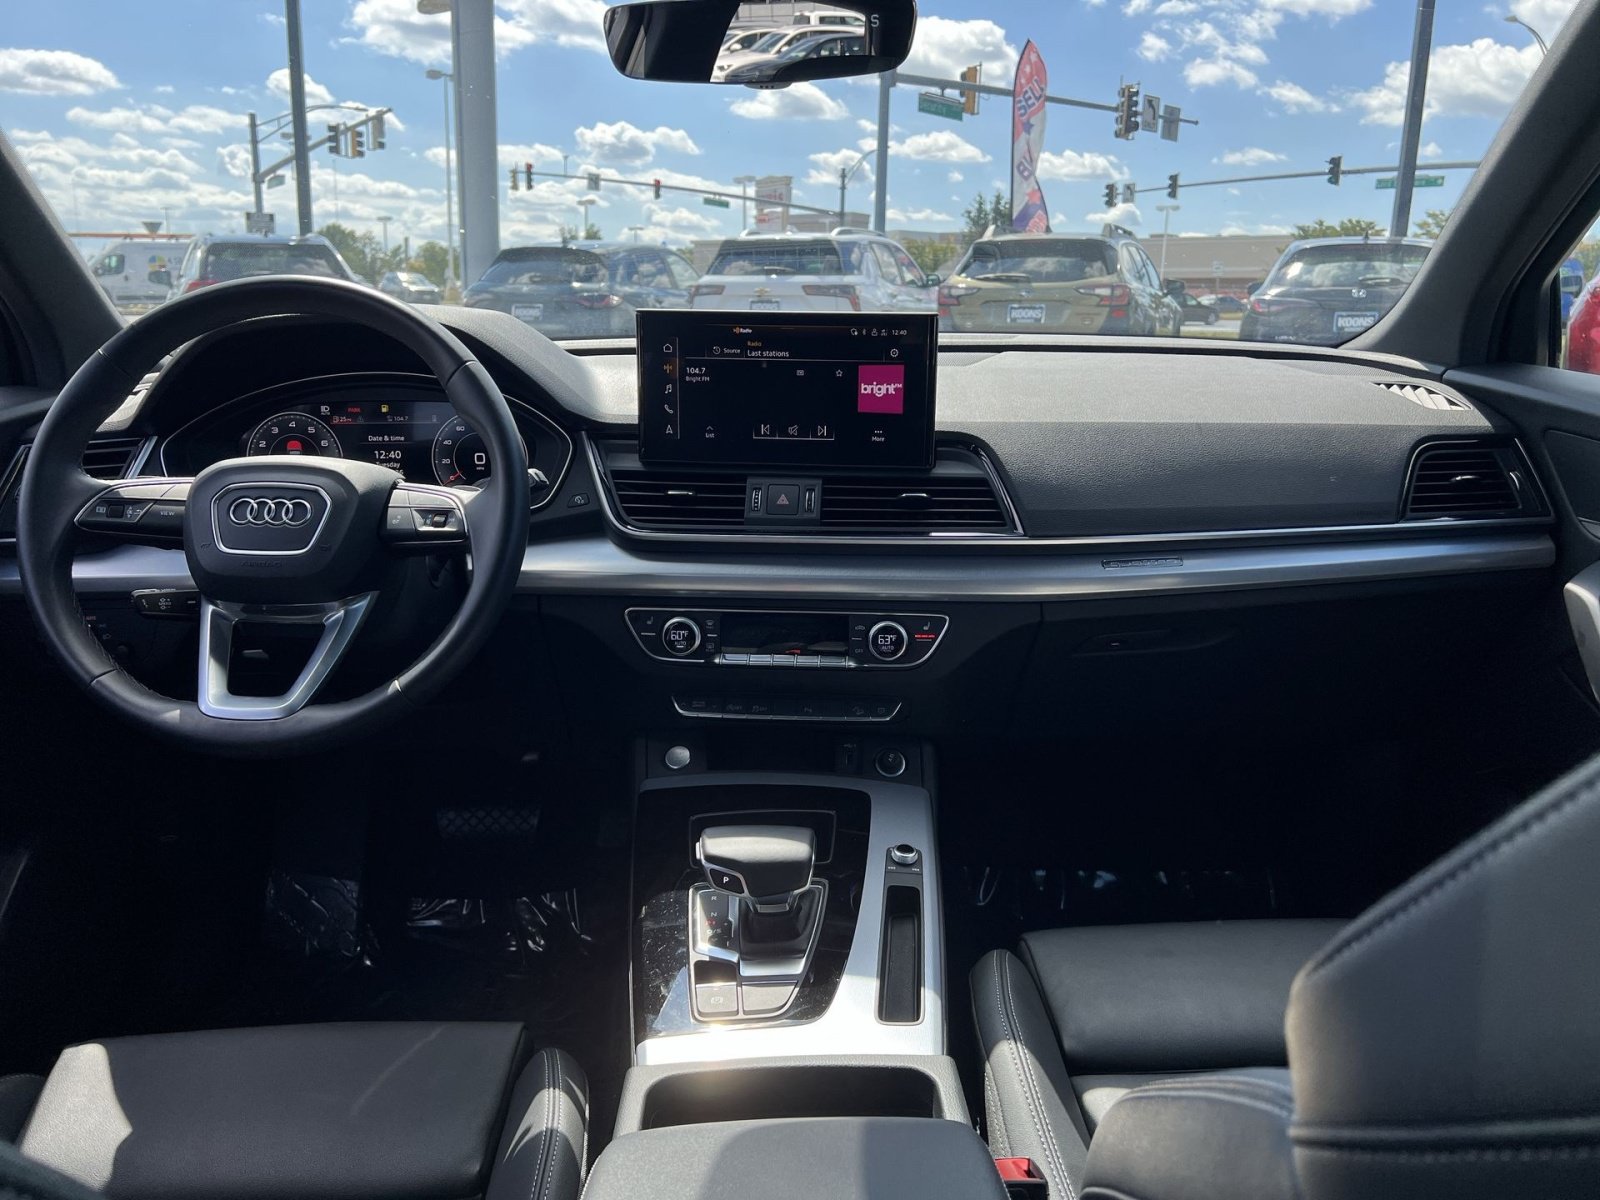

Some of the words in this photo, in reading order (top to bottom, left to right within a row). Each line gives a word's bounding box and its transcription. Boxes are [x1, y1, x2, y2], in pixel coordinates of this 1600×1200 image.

[870, 14, 880, 27] S
[1010, 309, 1042, 319] KOONS
[1337, 316, 1376, 327] KOONS
[861, 381, 896, 397] bright
[271, 426, 279, 434] 3
[307, 426, 316, 434] 5
[258, 440, 267, 448] 2
[374, 450, 402, 460] 12:40
[474, 452, 486, 465] 0
[723, 876, 730, 884] P
